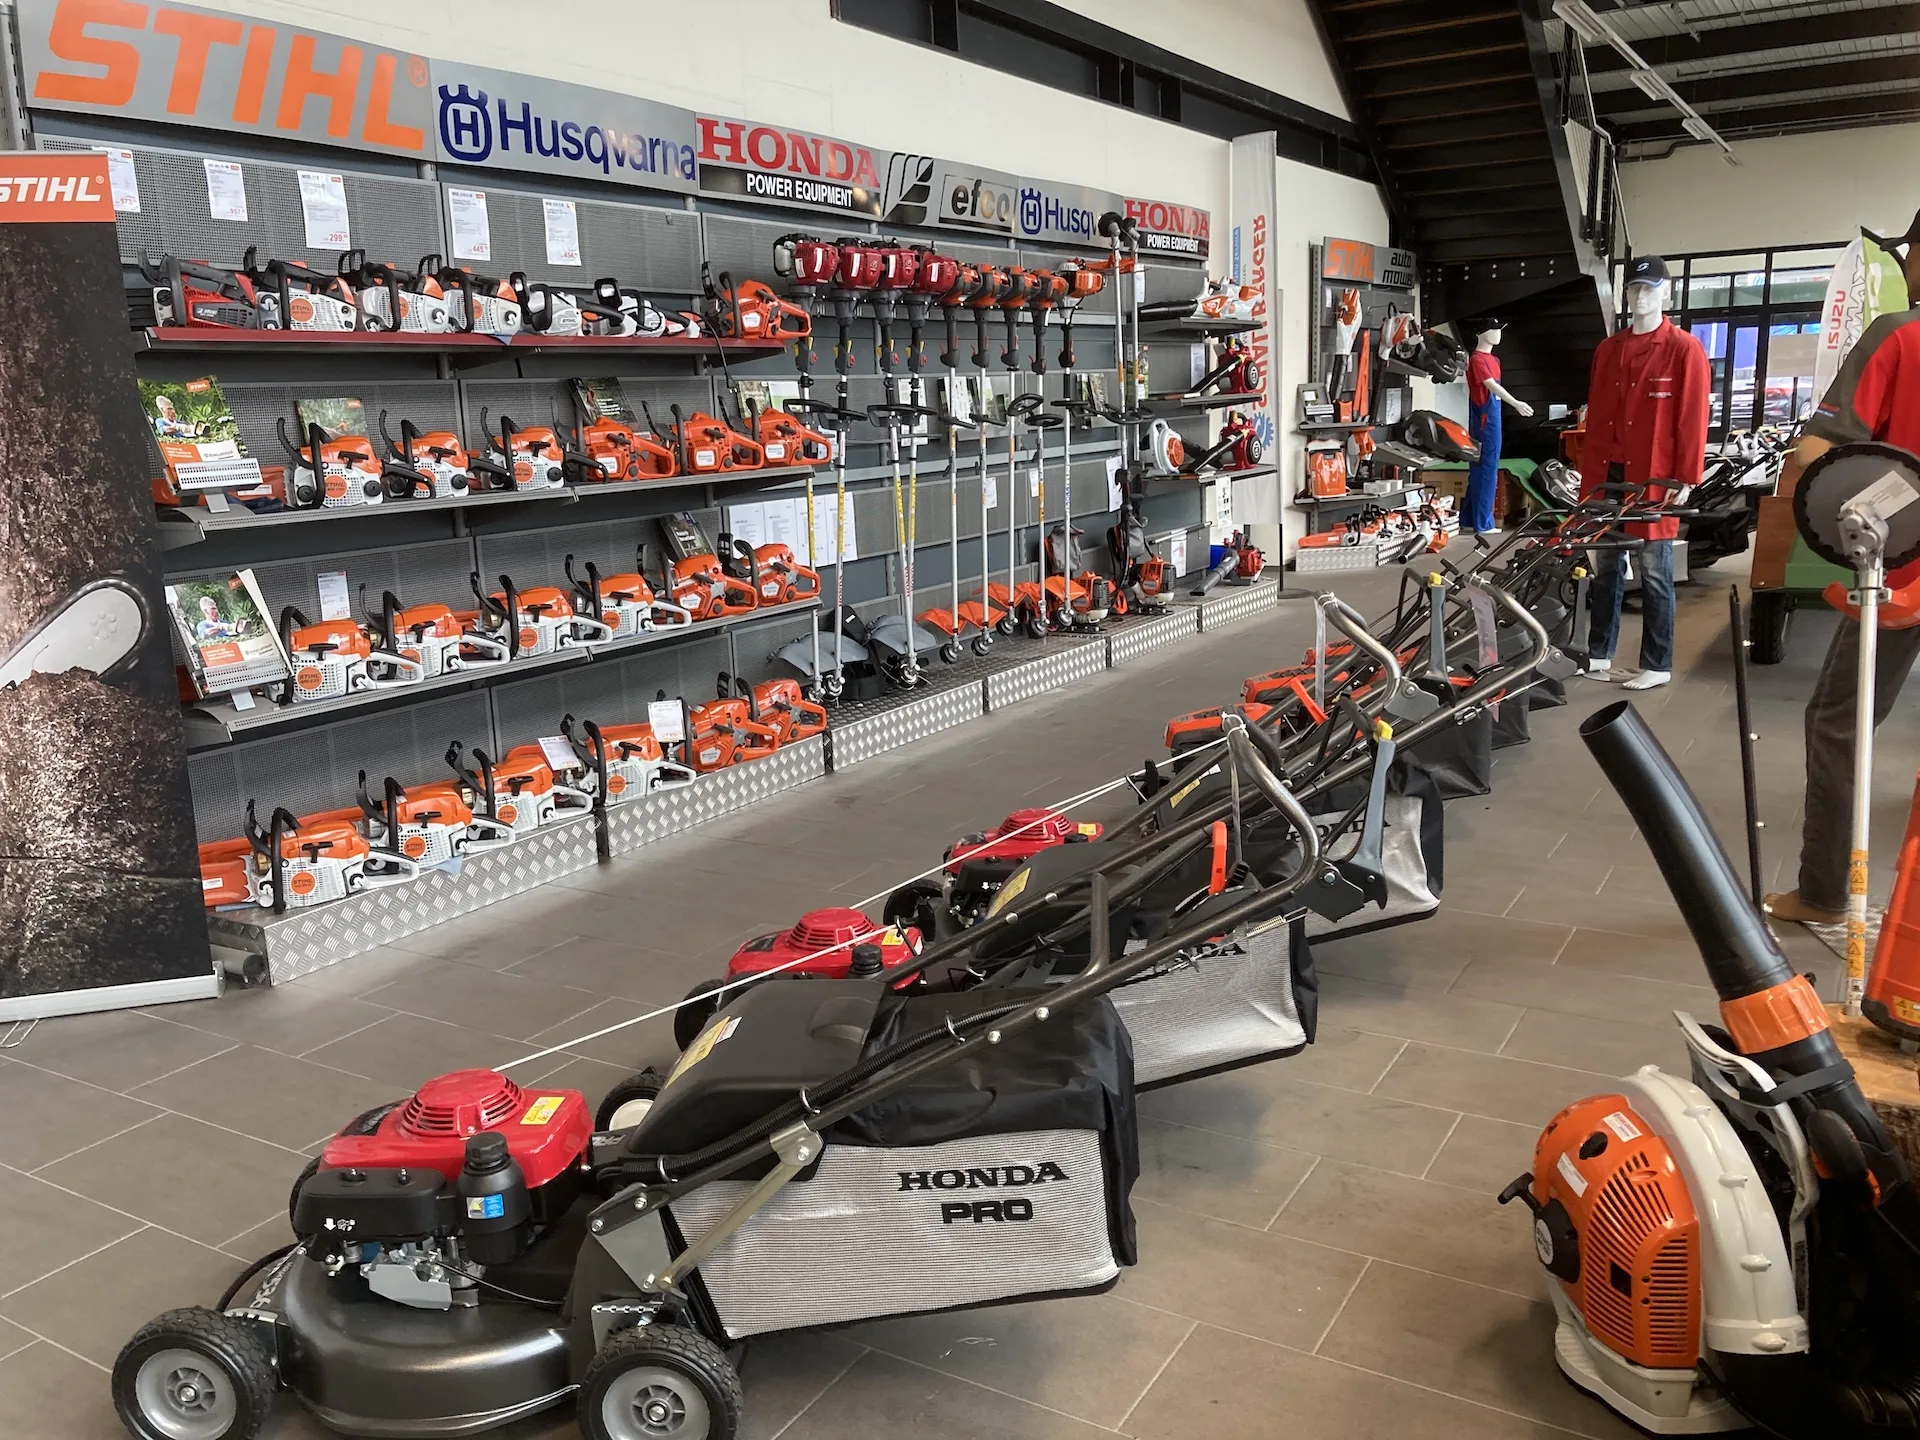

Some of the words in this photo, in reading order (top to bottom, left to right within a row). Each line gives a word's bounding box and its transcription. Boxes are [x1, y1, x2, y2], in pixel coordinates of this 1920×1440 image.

[499, 97, 696, 180] Husqvarna
[696, 117, 881, 188] HONDA
[746, 172, 792, 201] POWER
[795, 178, 853, 208] EQUIPMENT
[951, 177, 1014, 222] efco
[1044, 197, 1101, 238] Husqv
[1124, 200, 1210, 239] HONDA
[1147, 233, 1170, 250] POWER
[1172, 237, 1199, 252] EQUIPMENT
[1324, 240, 1375, 279] STIHL
[1391, 252, 1411, 268] auto
[1827, 290, 1846, 350] ISUZU
[898, 1161, 1069, 1192] HONDA
[941, 1199, 1033, 1224] PRO
